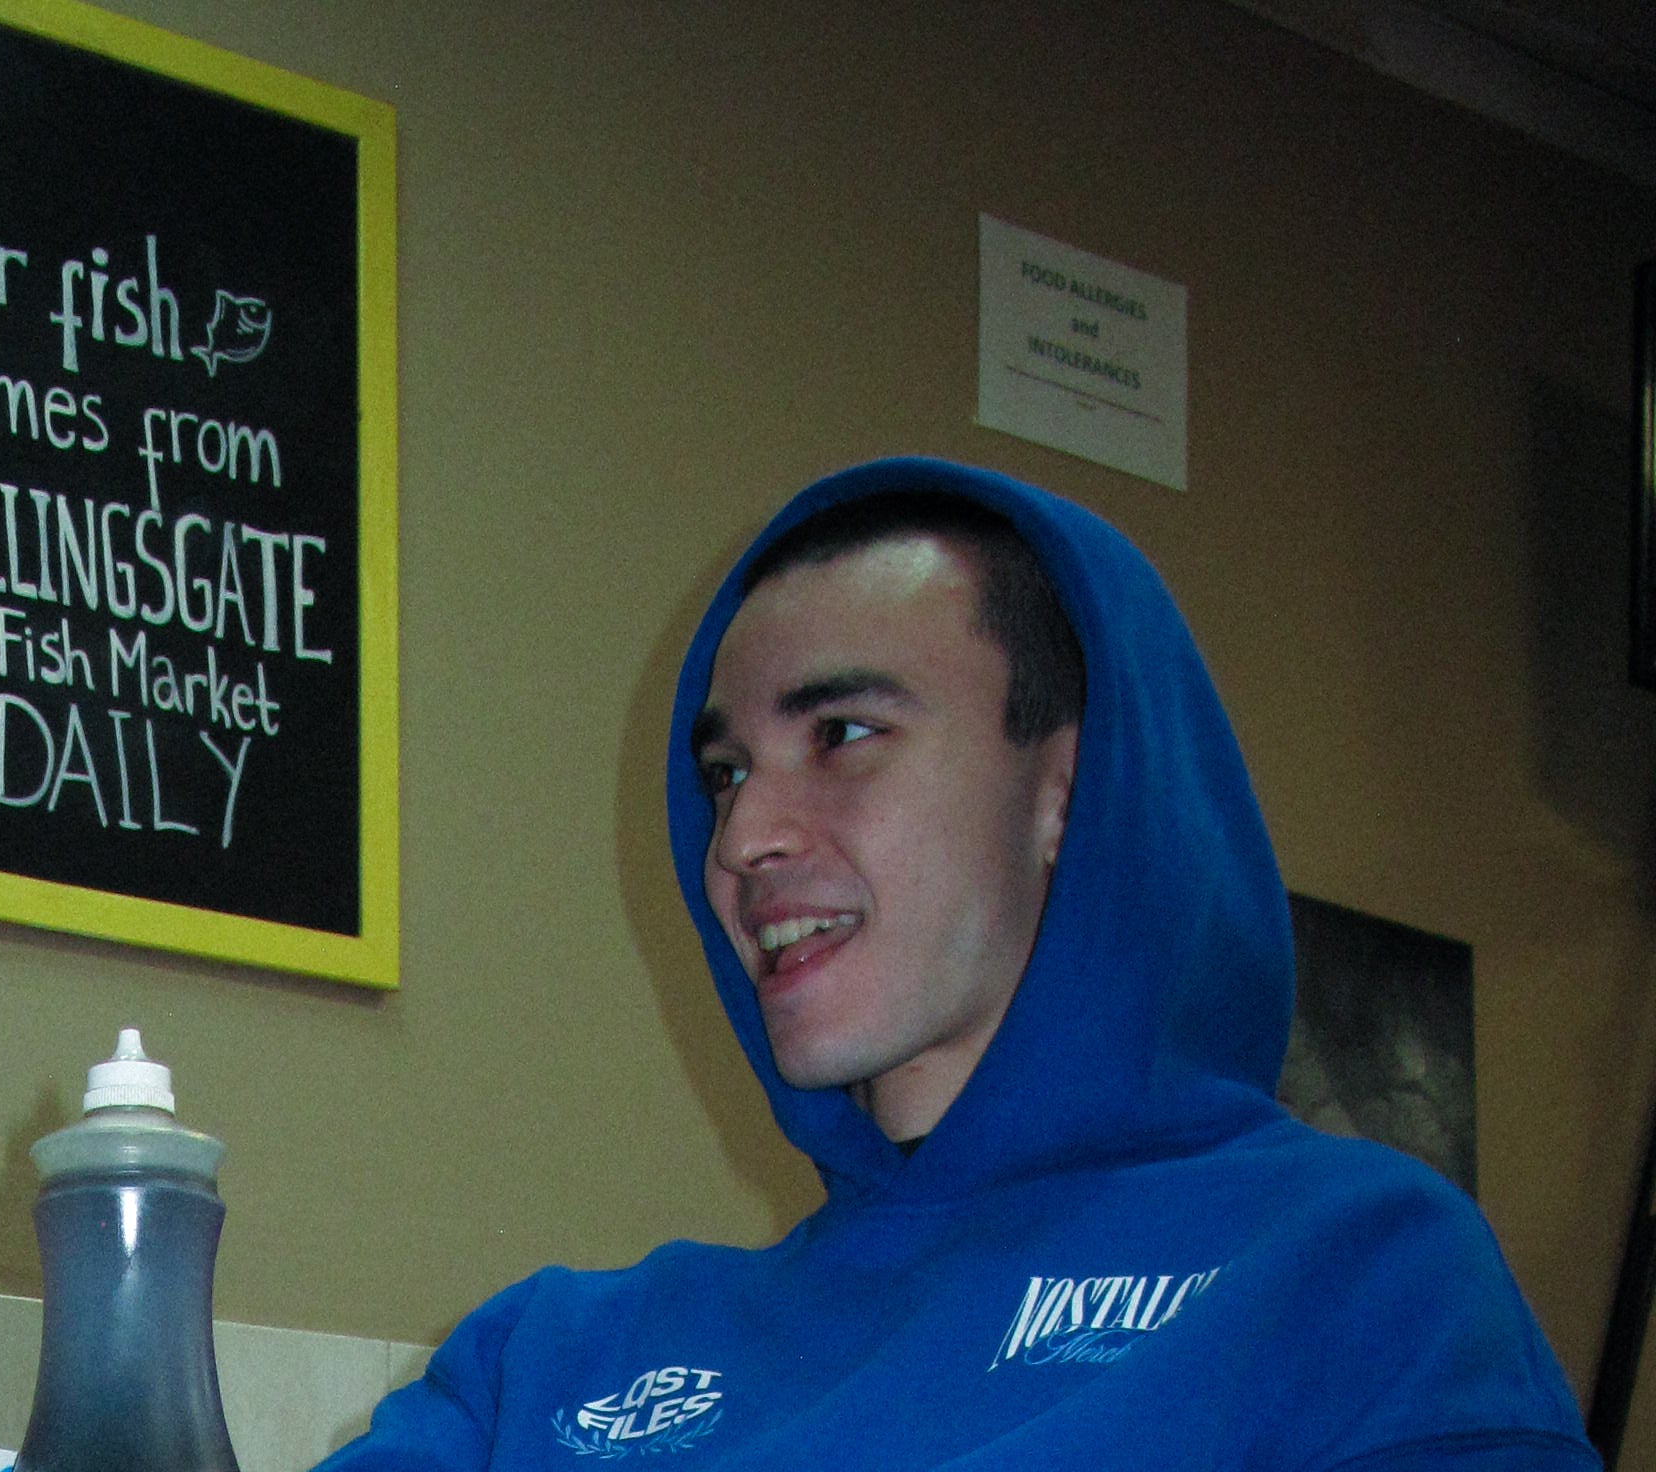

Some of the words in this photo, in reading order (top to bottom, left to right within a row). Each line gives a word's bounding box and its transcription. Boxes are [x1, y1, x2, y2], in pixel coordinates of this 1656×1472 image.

[49, 234, 183, 372] fish
[138, 407, 282, 510] from
[109, 628, 280, 736] Market
[577, 1391, 723, 1440] FILES
[583, 1365, 722, 1412] LOST
